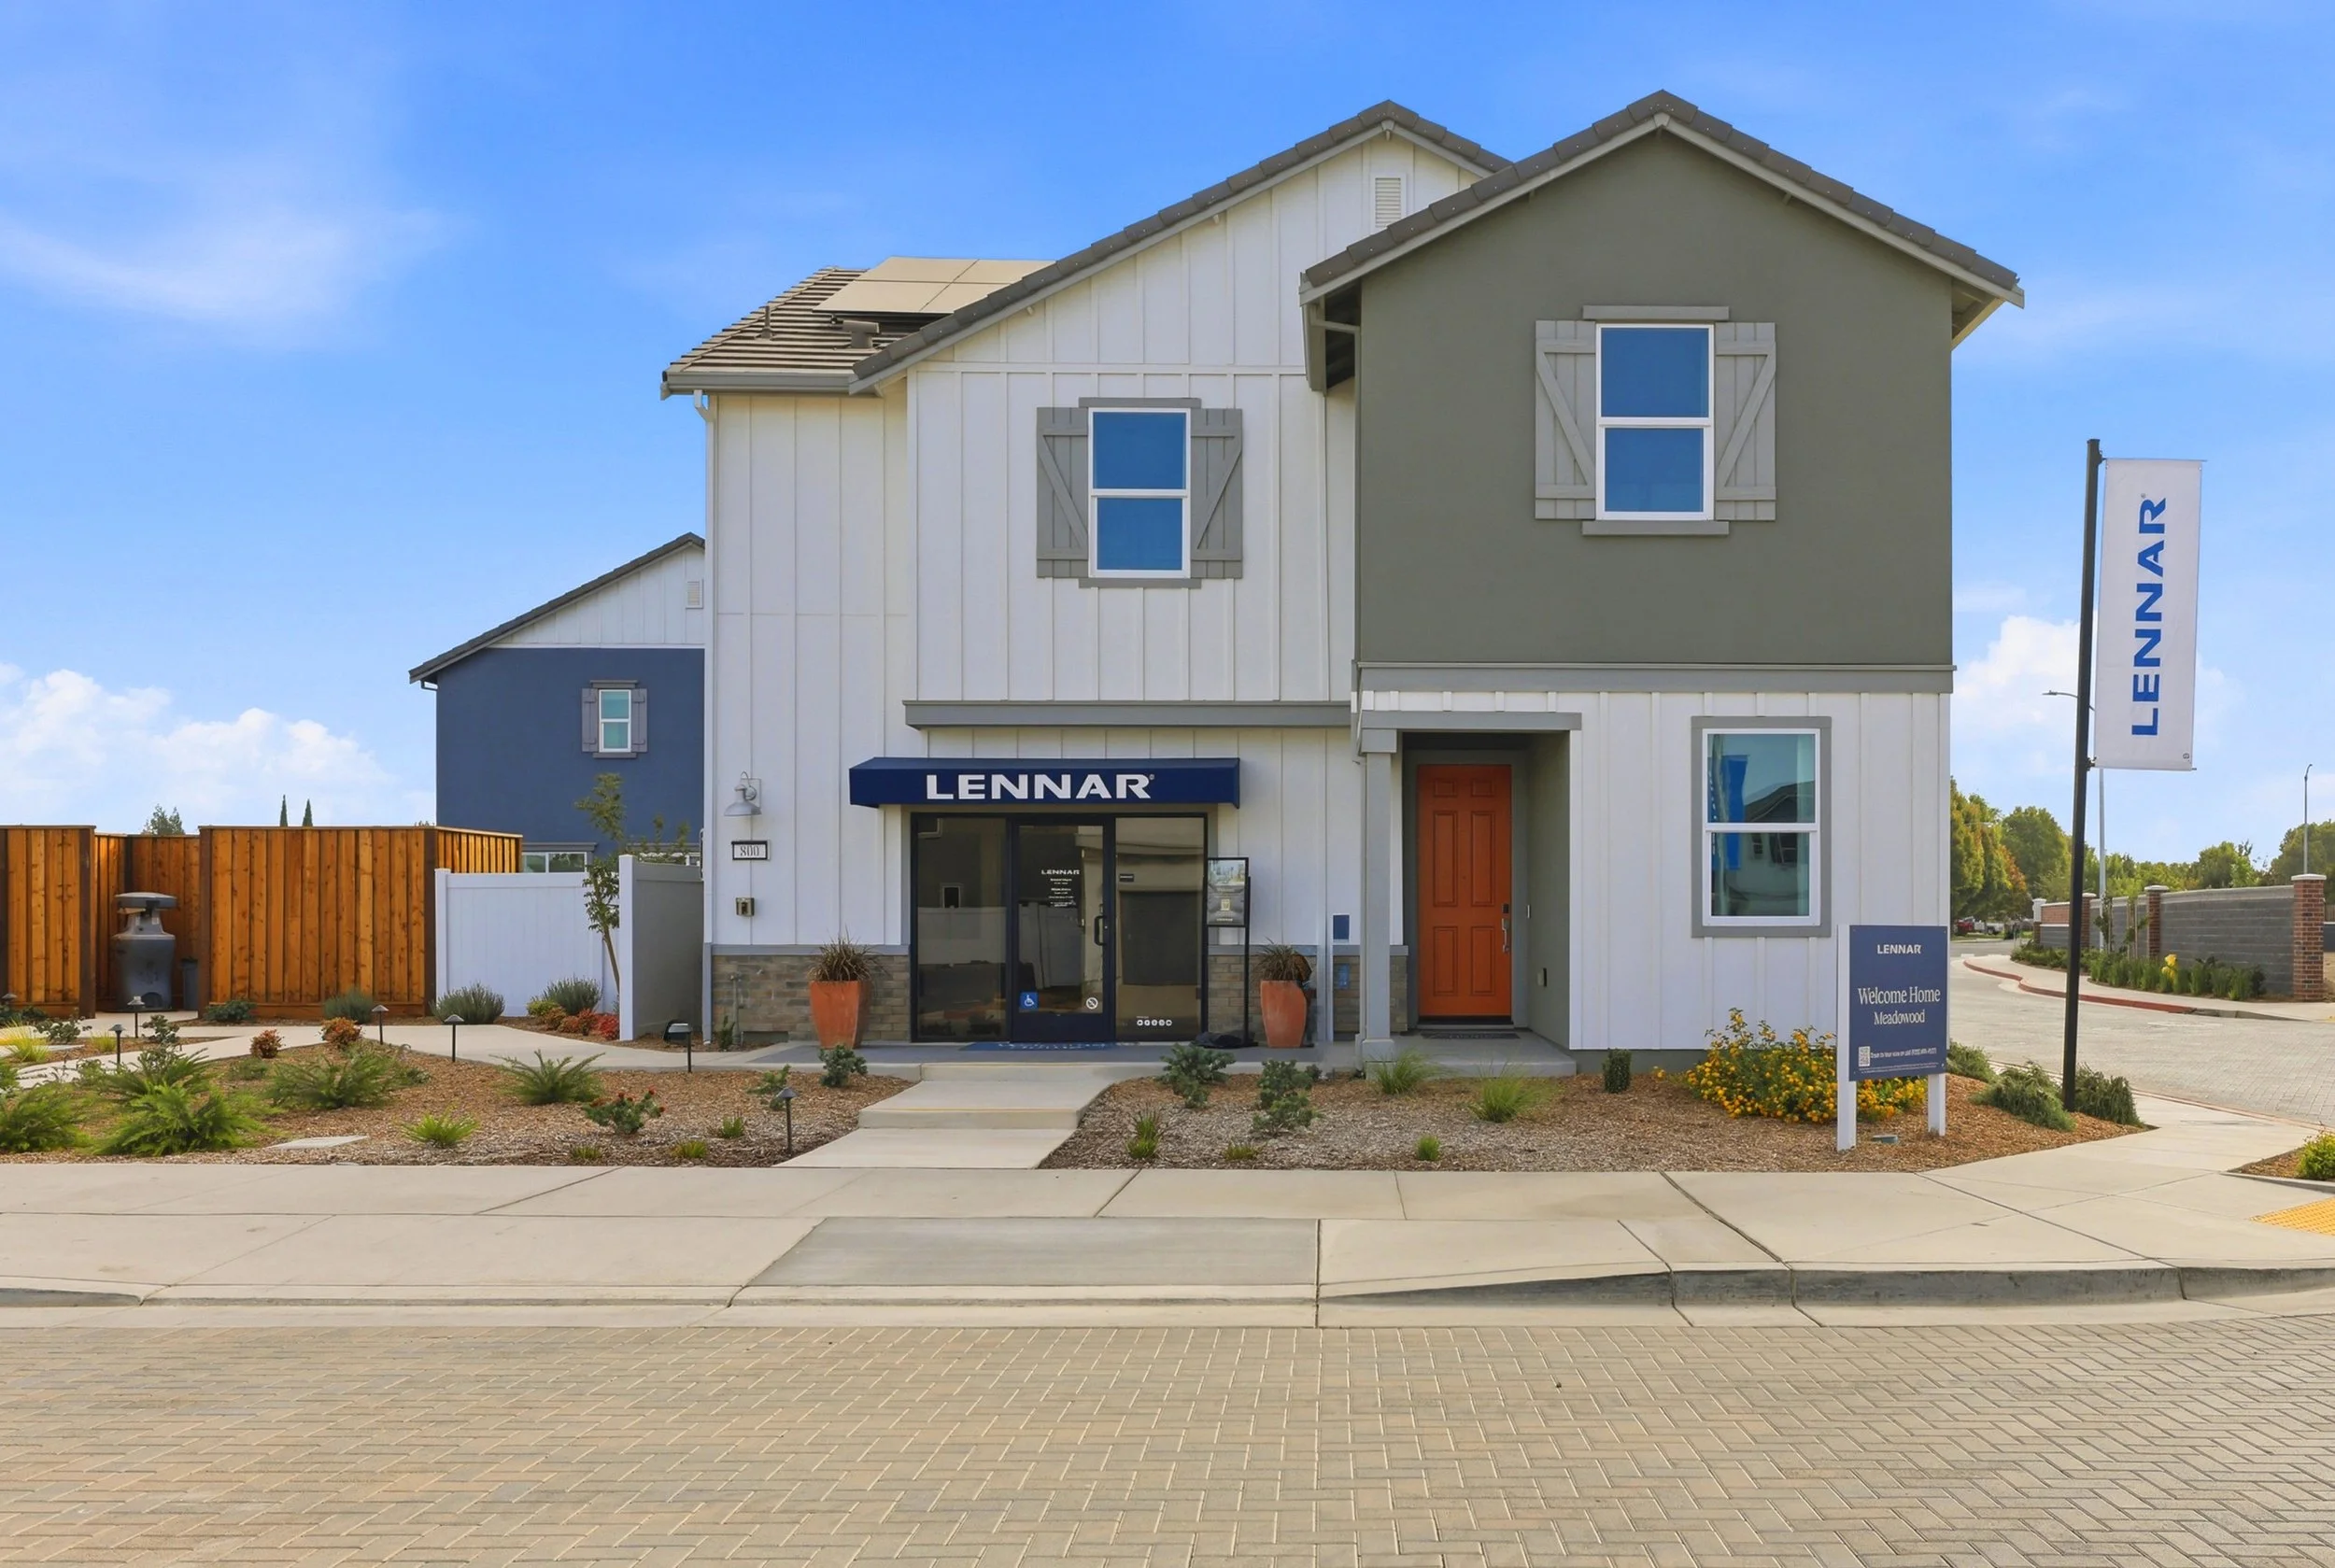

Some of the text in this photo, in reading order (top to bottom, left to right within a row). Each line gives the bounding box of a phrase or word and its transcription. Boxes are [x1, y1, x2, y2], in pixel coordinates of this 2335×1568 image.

[2131, 497, 2167, 736] LENNAR
[927, 774, 1151, 799] LENNAR
[740, 845, 759, 856] 800
[1877, 944, 1921, 954] LENNAR
[1858, 986, 1941, 1005] Welcome Home
[1874, 1010, 1926, 1025] Meadowood
